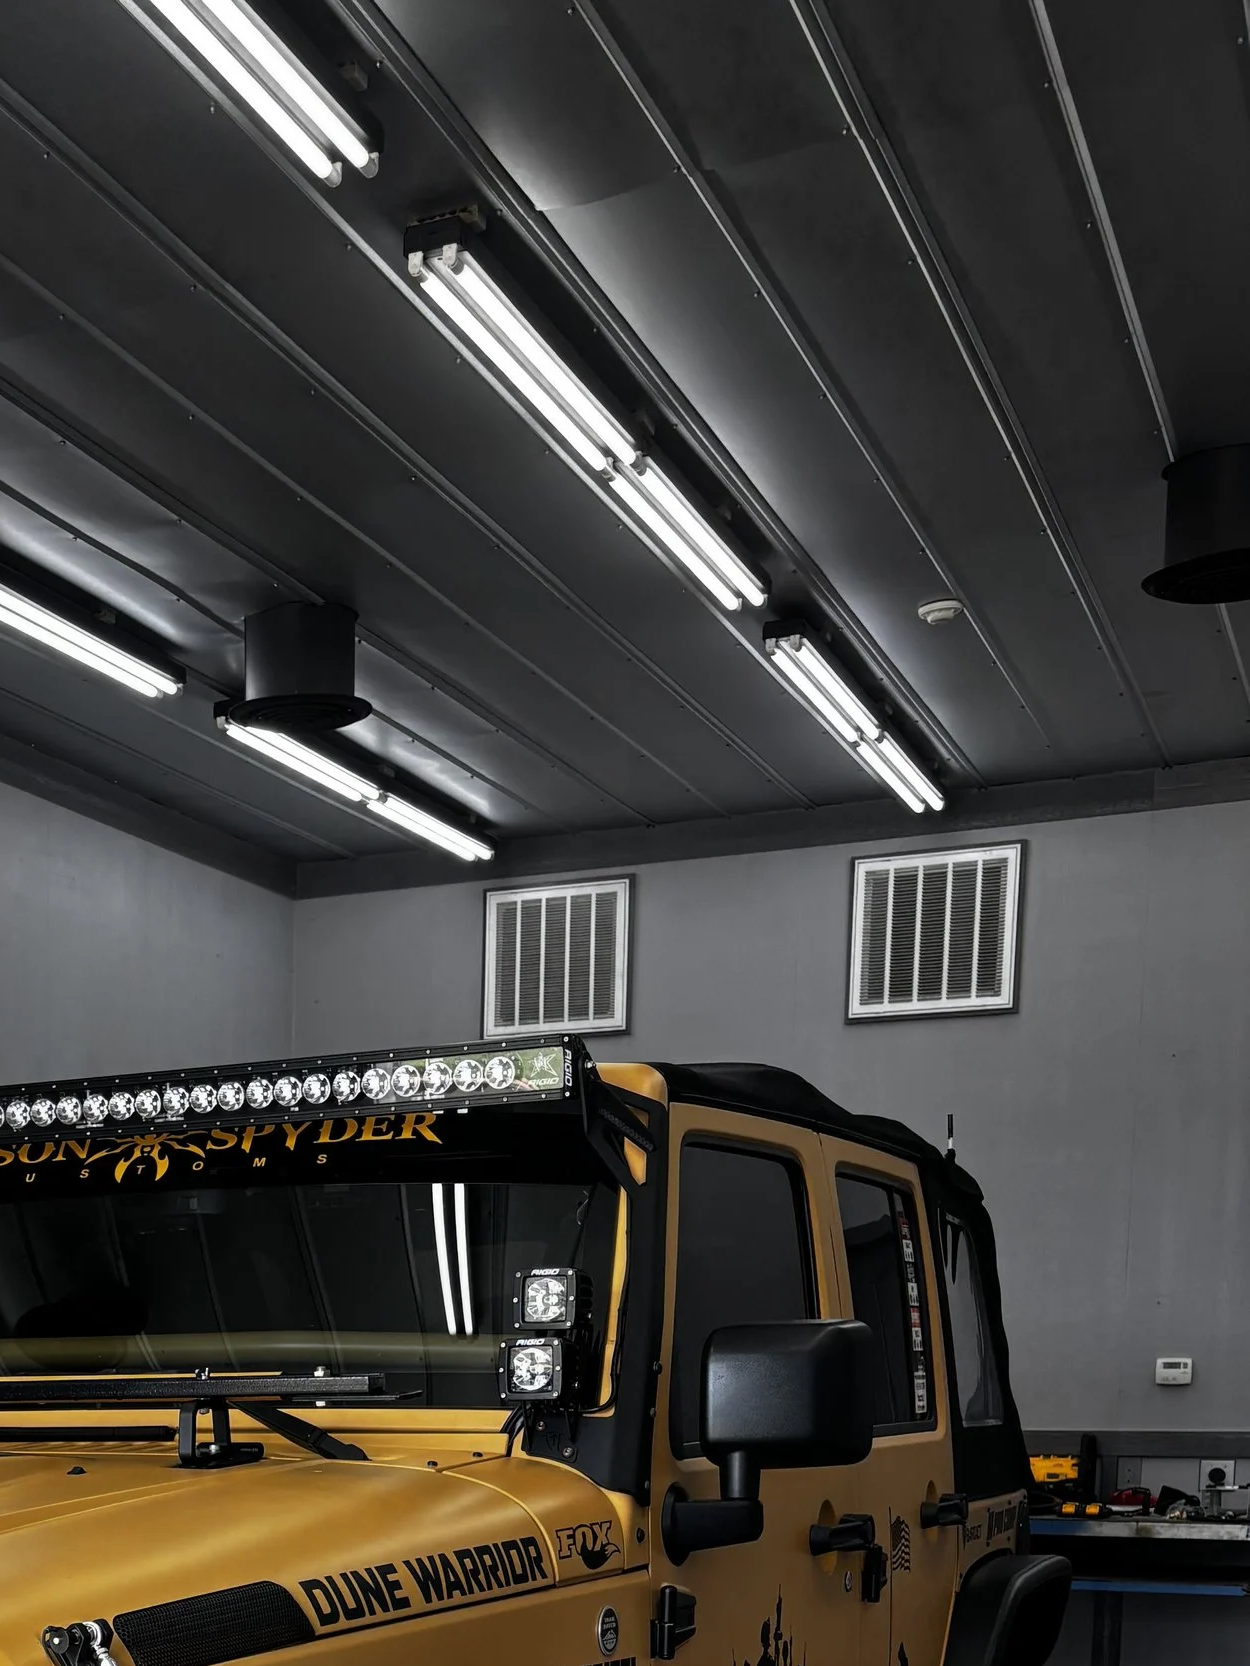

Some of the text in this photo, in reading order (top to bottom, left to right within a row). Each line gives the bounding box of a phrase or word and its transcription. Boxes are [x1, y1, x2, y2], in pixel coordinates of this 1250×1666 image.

[564, 1048, 573, 1088] RIGID
[206, 1112, 444, 1152] SPYDER
[531, 1268, 560, 1276] RIGID
[515, 1338, 546, 1346] RIGID
[555, 1521, 612, 1560] FOX
[298, 1536, 549, 1627] DUNE WARRIOR
